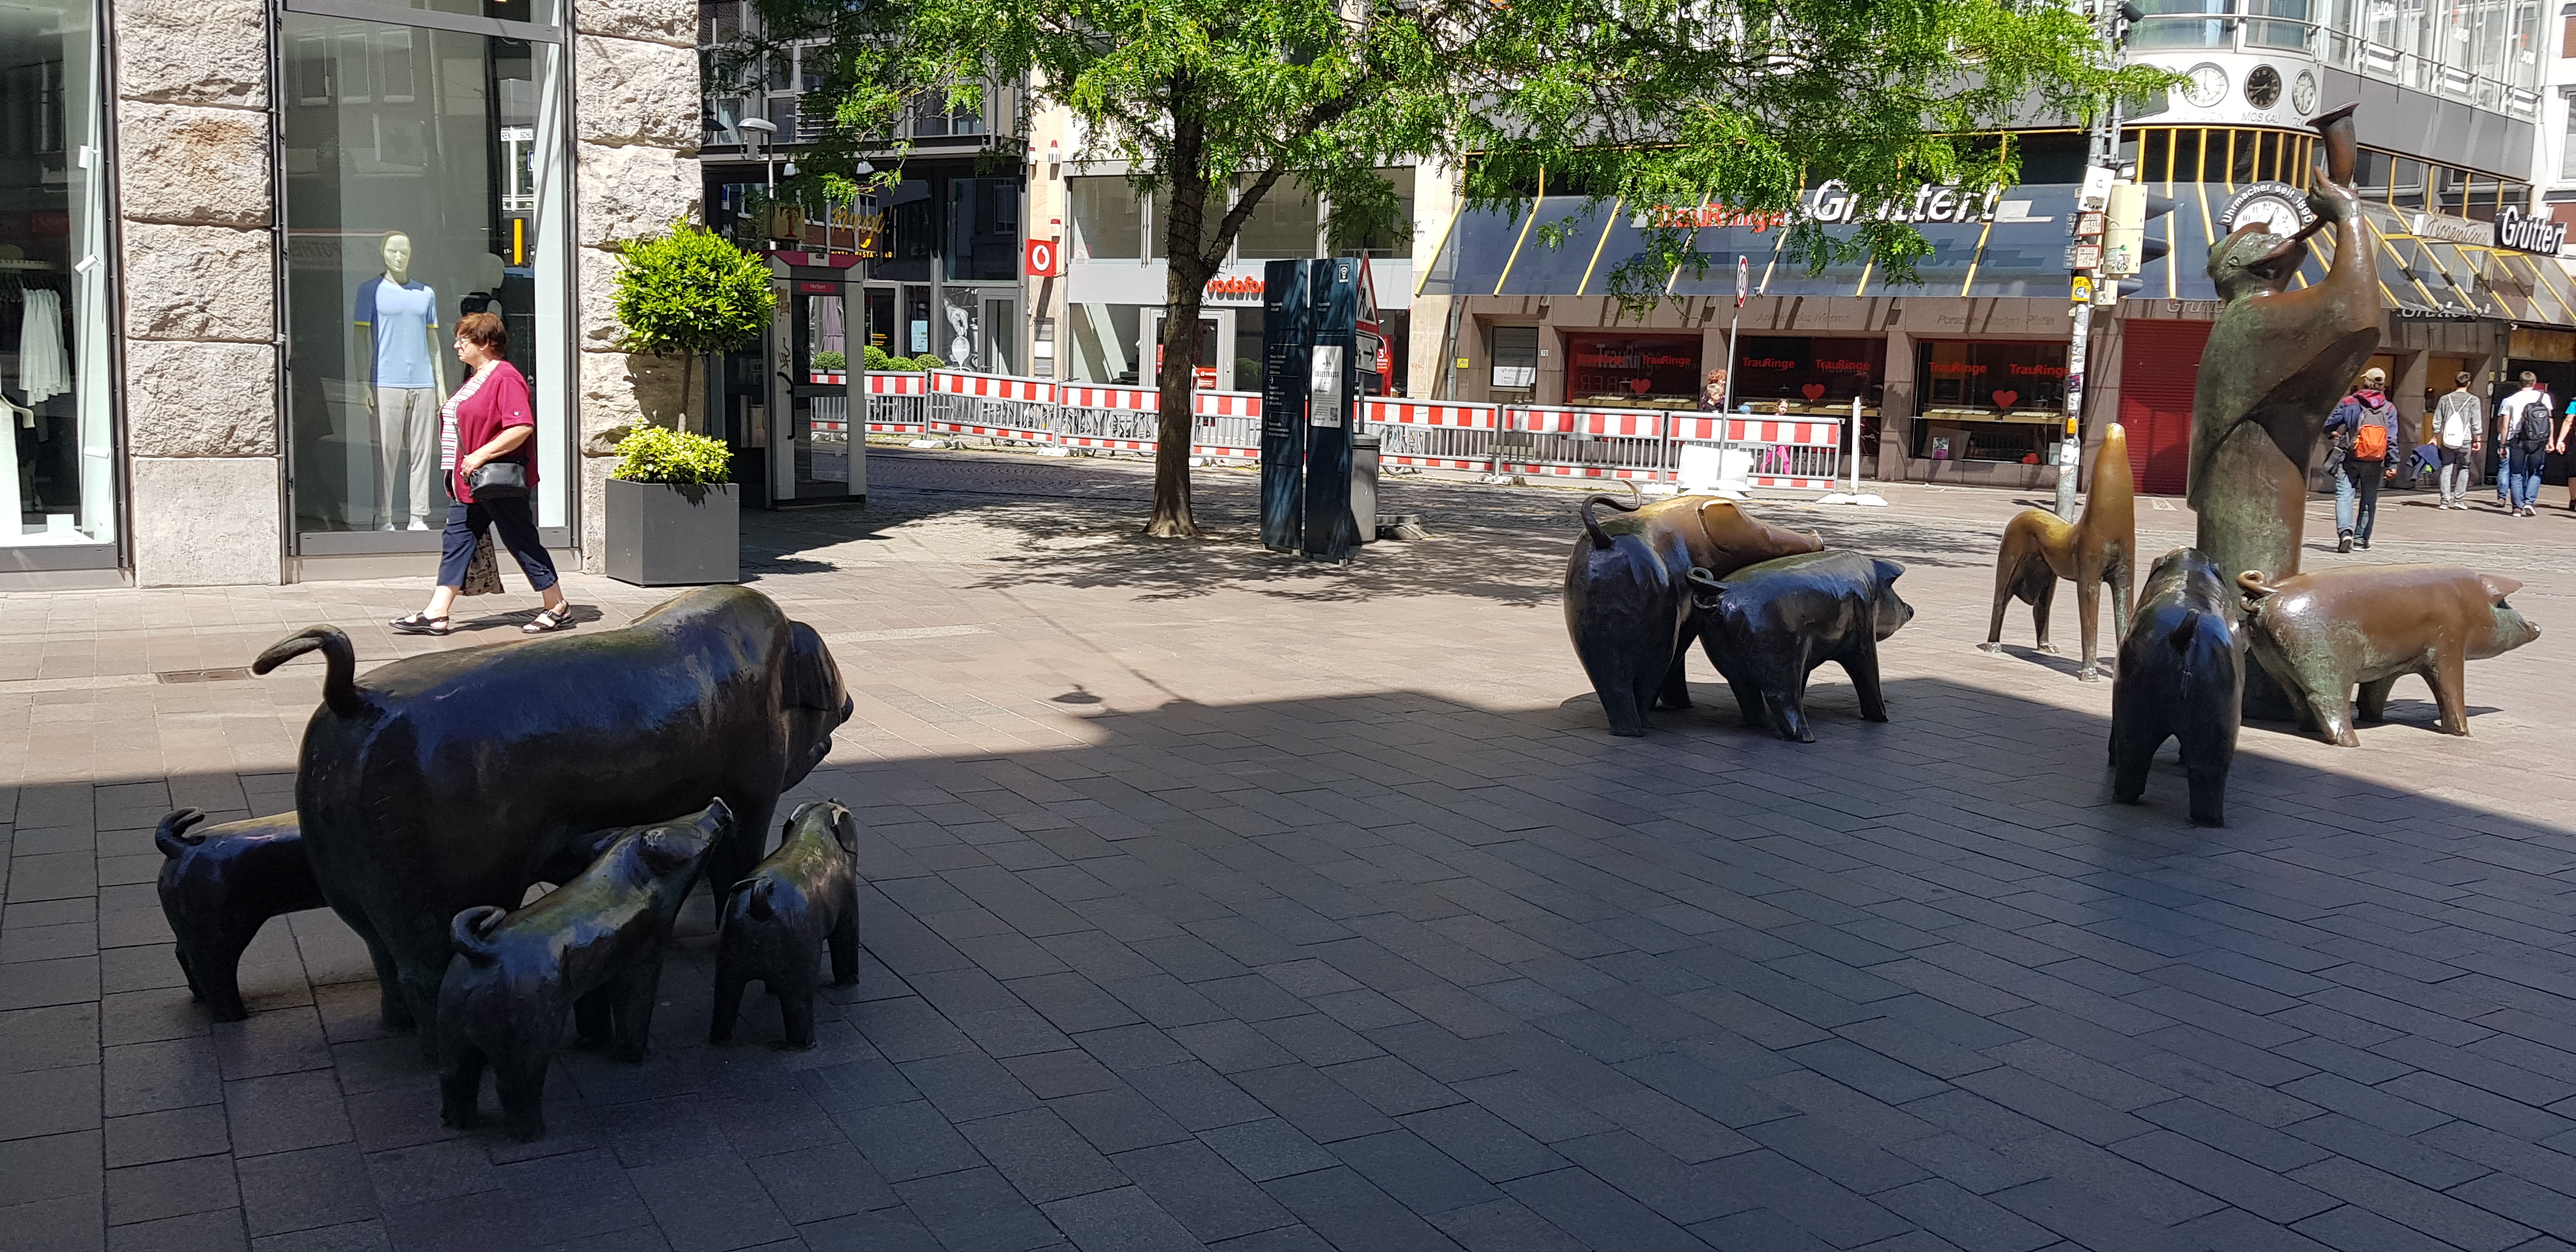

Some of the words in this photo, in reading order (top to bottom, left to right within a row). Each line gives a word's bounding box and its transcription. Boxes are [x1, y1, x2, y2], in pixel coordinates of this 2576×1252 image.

[2241, 111, 2281, 124] MOSKAU
[2221, 183, 2271, 224] Uhrmacher
[2274, 185, 2296, 199] seit
[2295, 195, 2314, 224] 1890
[1739, 269, 1746, 291] 30
[1642, 355, 1692, 367] TrauRinge
[1743, 357, 1795, 370] TrauRinge
[1815, 359, 1871, 372] TrauRinge
[1928, 362, 1988, 376] TrauRinge
[2009, 363, 2071, 378] TrauRinge
